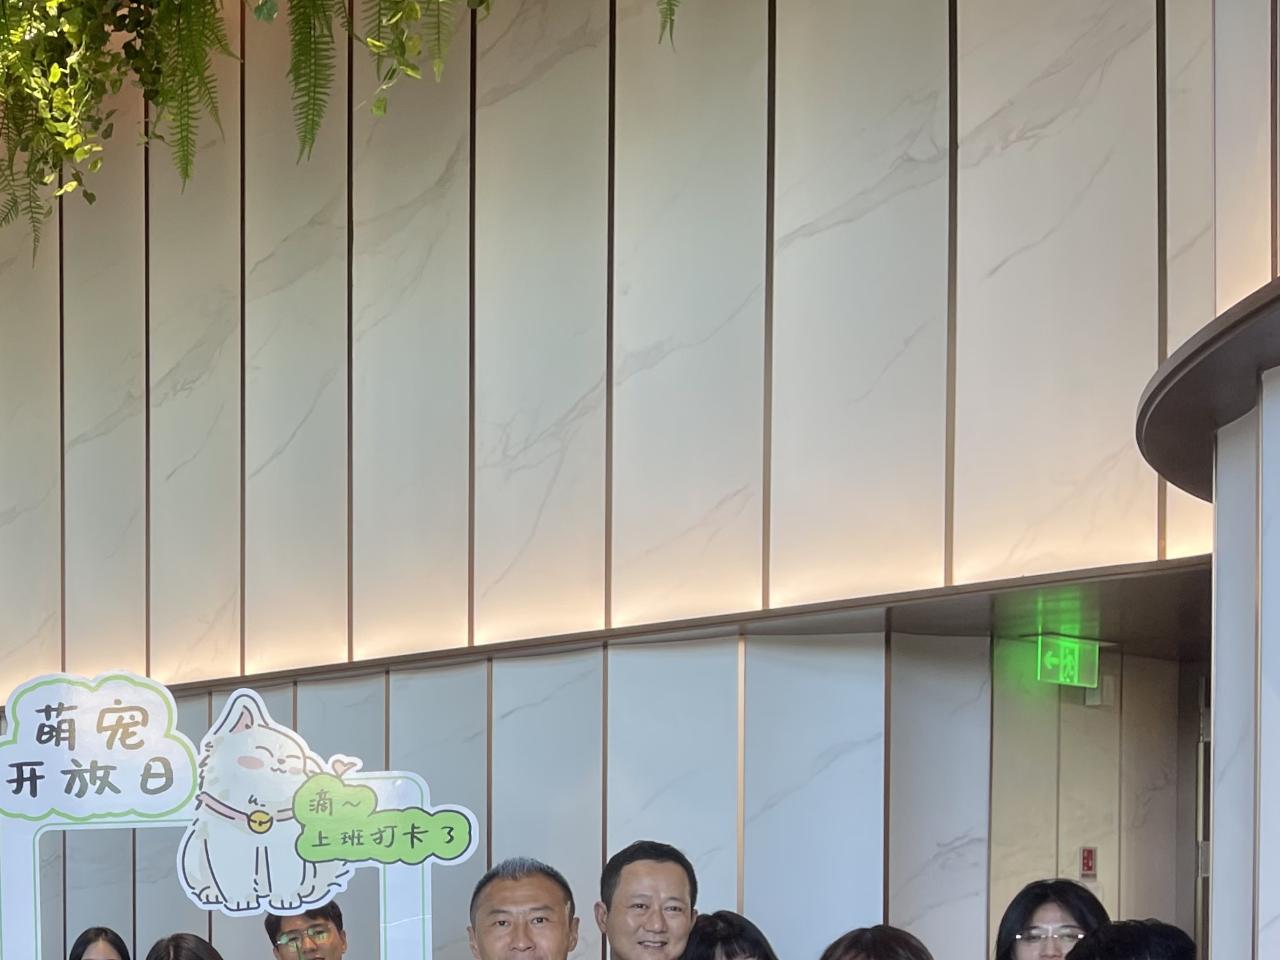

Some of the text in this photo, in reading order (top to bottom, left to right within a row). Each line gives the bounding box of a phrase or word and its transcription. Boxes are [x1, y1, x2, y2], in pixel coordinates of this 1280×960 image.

[35, 698, 149, 752] 萌宠
[5, 756, 174, 799] 开放日
[311, 822, 456, 849] 上班打卡了
